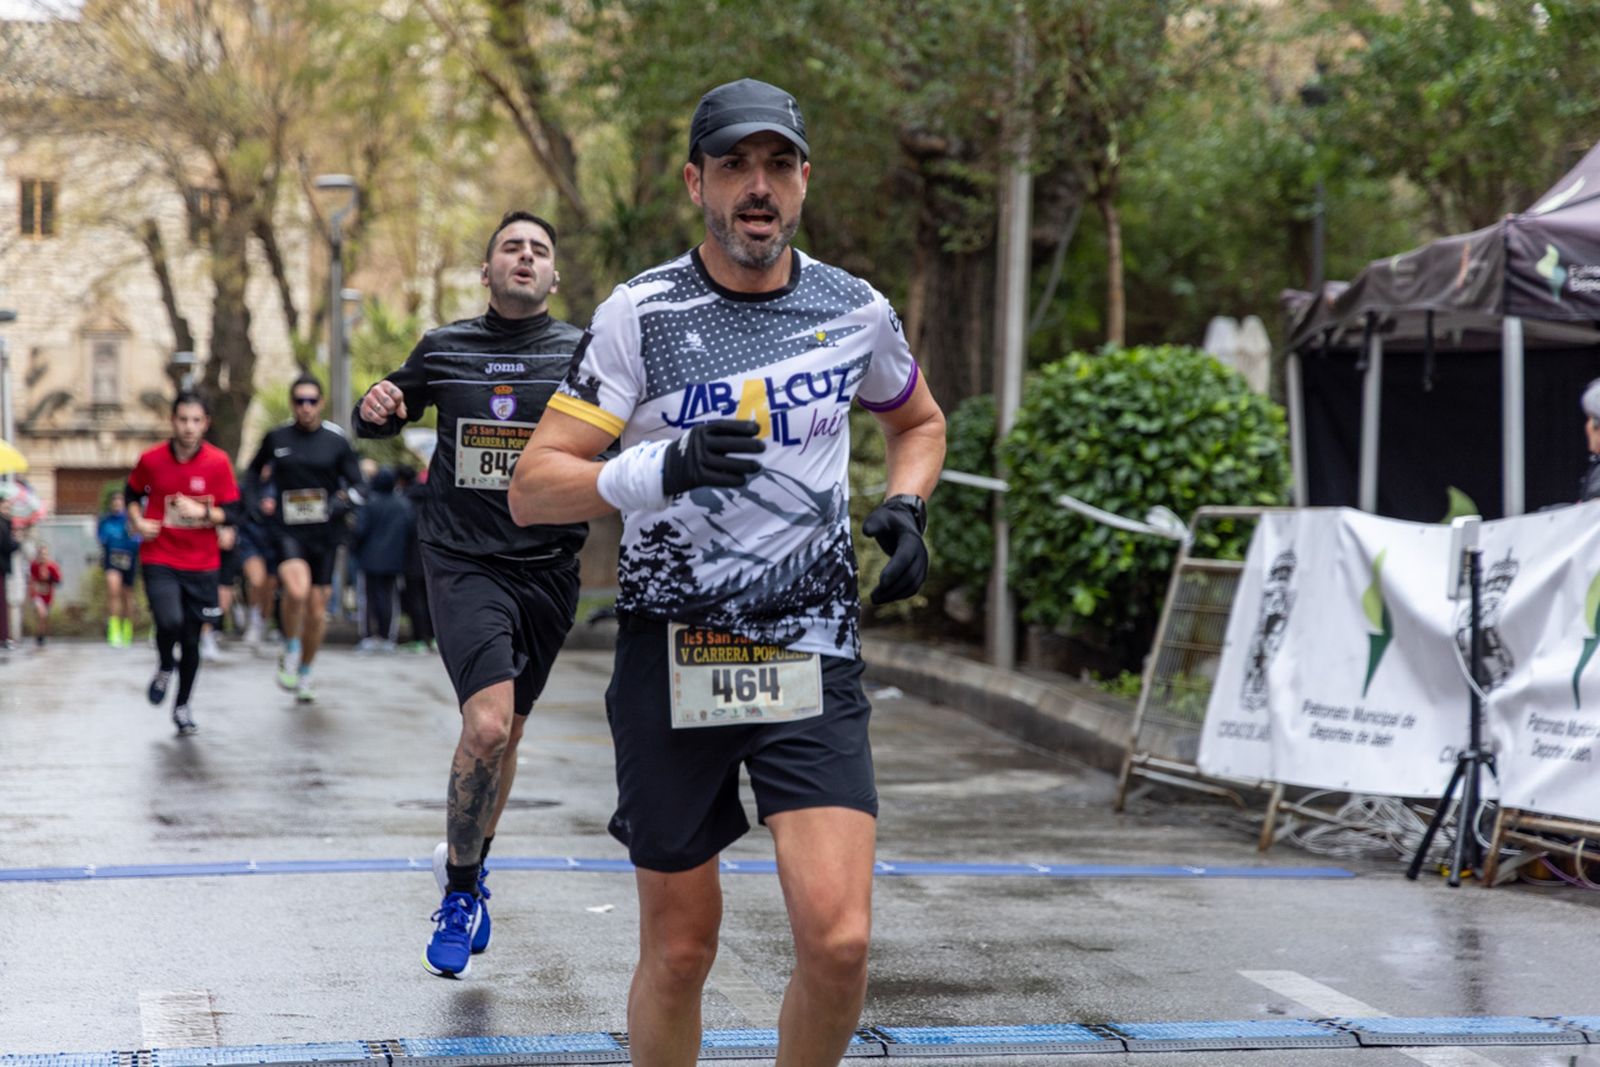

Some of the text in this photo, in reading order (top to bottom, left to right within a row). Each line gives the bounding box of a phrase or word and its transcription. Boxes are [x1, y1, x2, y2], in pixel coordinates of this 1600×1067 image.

[485, 363, 525, 374] Joma
[661, 367, 851, 427] JABALCUZ
[798, 408, 844, 455] Jaé
[463, 436, 470, 446] V
[471, 436, 506, 447] CARRERA
[707, 630, 731, 644] San
[681, 648, 690, 662] V
[693, 646, 749, 662] CARRERA
[712, 666, 780, 703] 464
